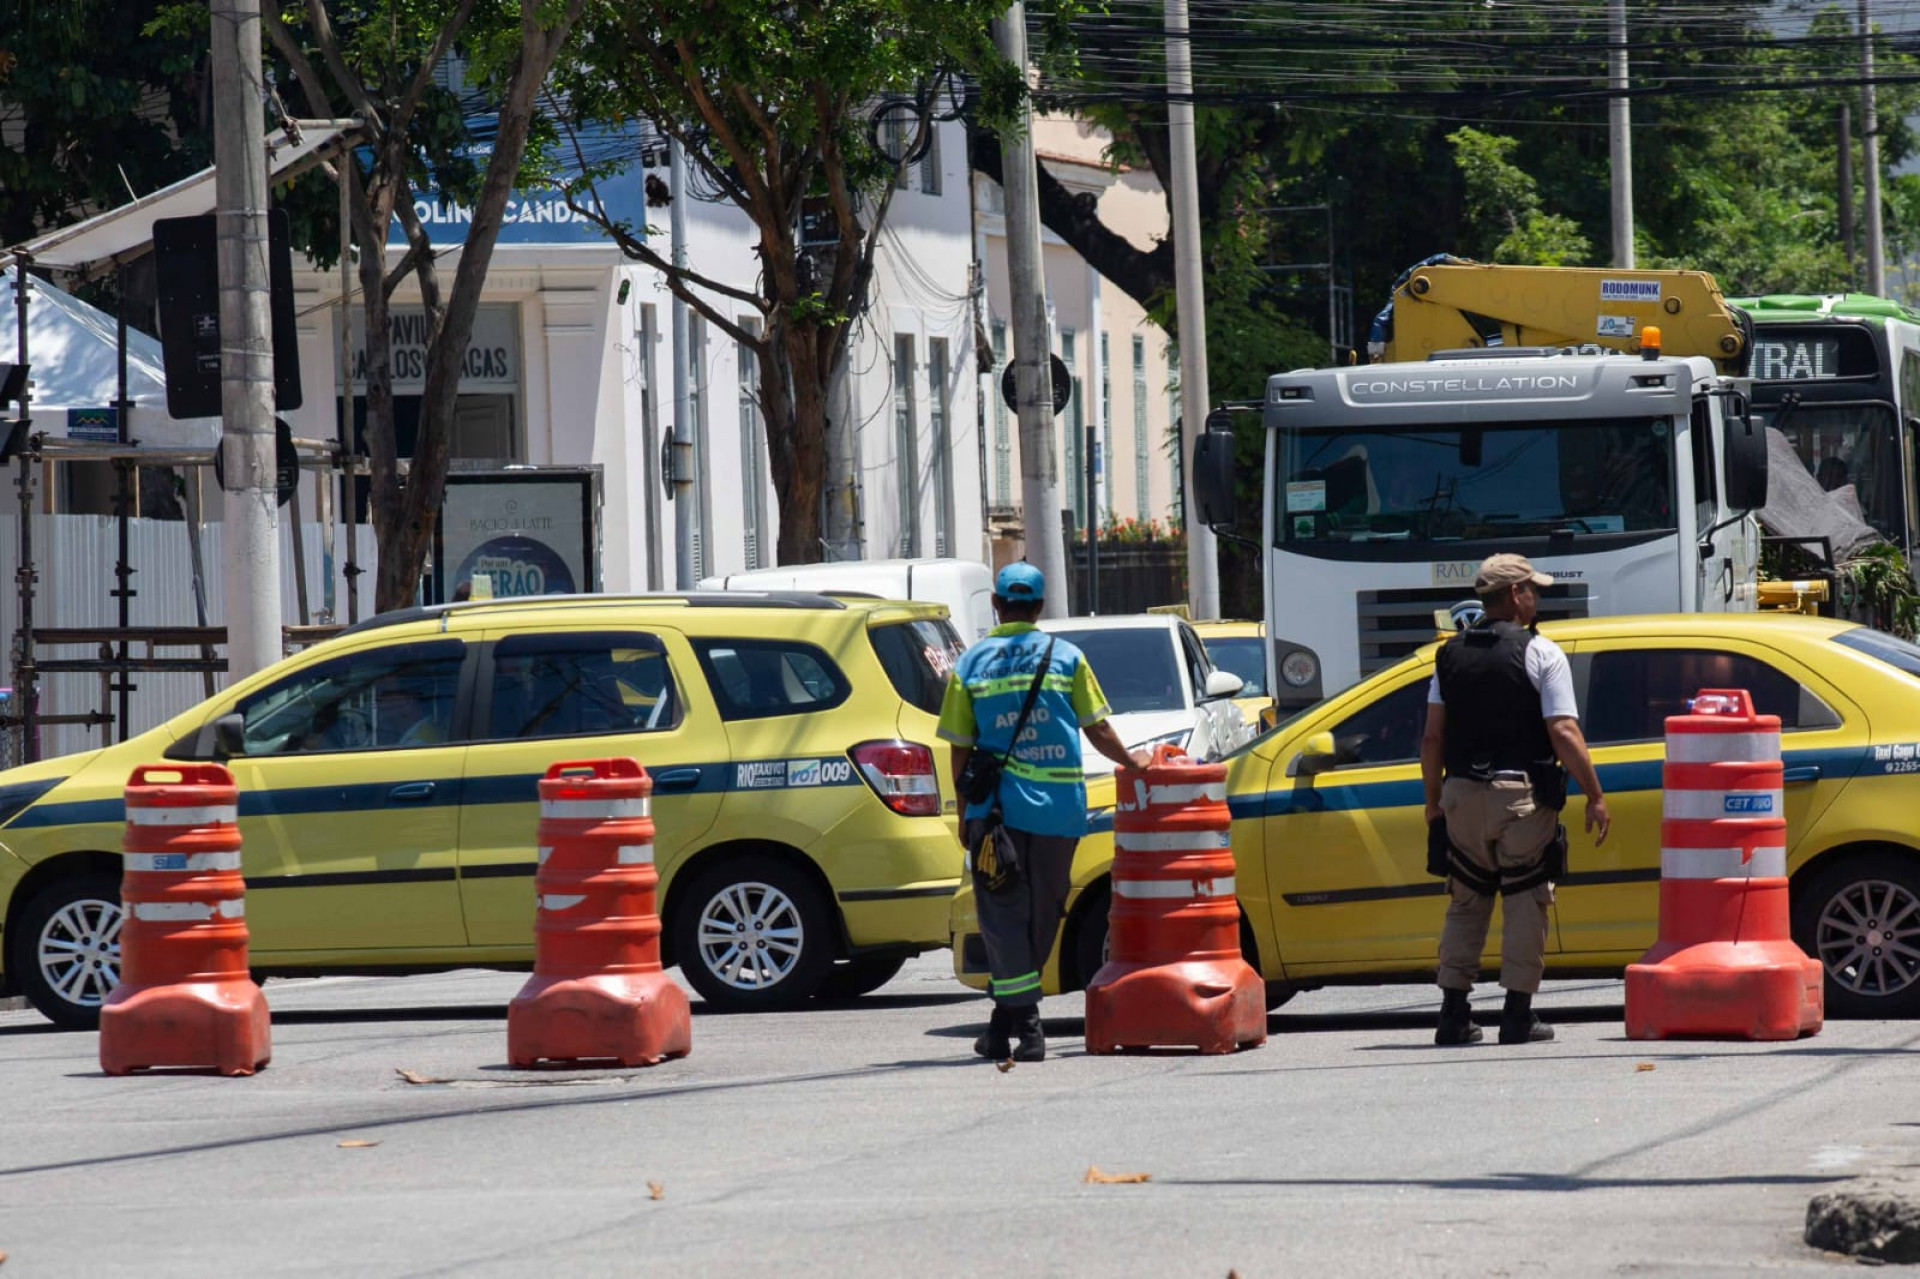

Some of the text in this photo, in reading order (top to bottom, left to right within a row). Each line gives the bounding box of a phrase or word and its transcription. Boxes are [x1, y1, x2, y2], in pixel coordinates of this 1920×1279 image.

[1602, 282, 1659, 295] RODOMUNK
[460, 348, 508, 378] AGAS
[1351, 376, 1578, 395] CONSTELLATION
[469, 517, 507, 531] BACIO
[522, 517, 554, 531] LATTE
[473, 564, 541, 597] ERÃO
[996, 707, 1050, 729] APIO
[738, 763, 755, 788] RIO
[821, 762, 850, 782] 009
